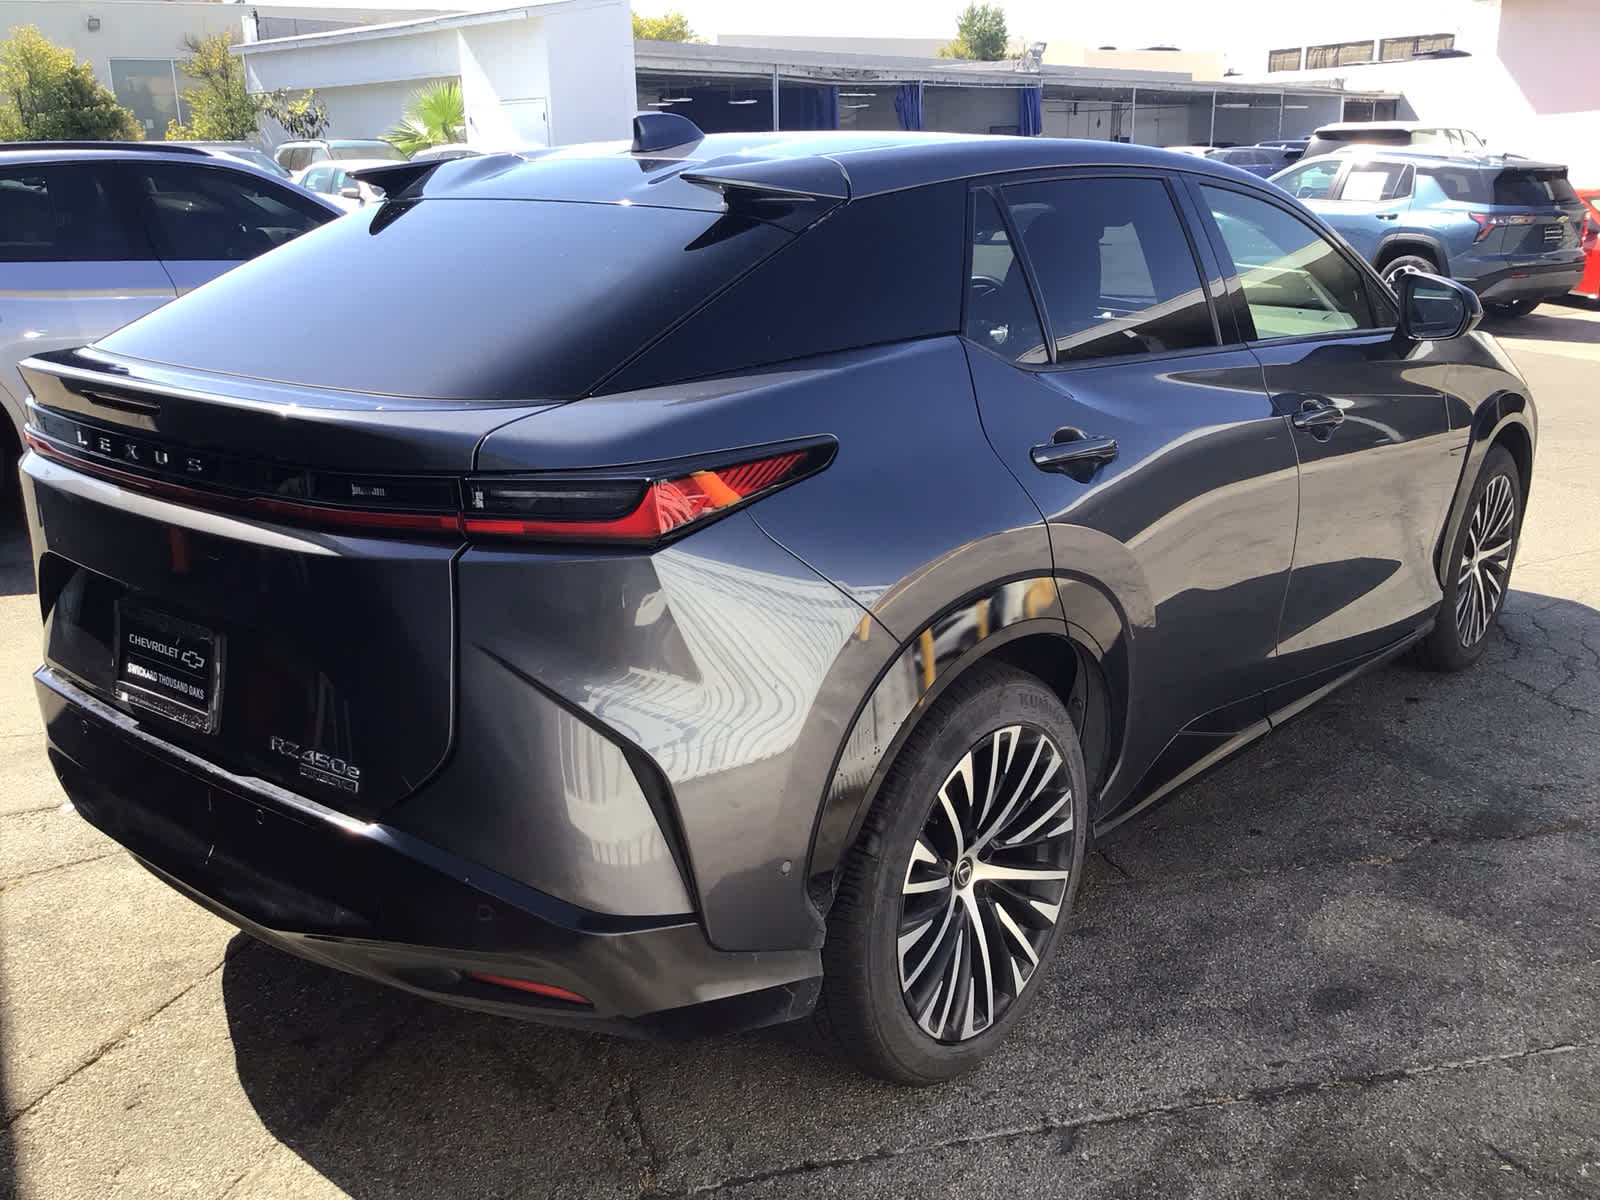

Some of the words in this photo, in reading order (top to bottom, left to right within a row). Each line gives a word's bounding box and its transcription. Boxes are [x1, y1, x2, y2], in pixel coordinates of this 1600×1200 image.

[75, 430, 203, 471] LEXUS
[129, 633, 179, 658] CHEVROLET
[158, 673, 188, 694] THOUSAND
[188, 685, 205, 700] OAKS
[271, 736, 302, 760] RZ
[301, 750, 360, 778] 450e
